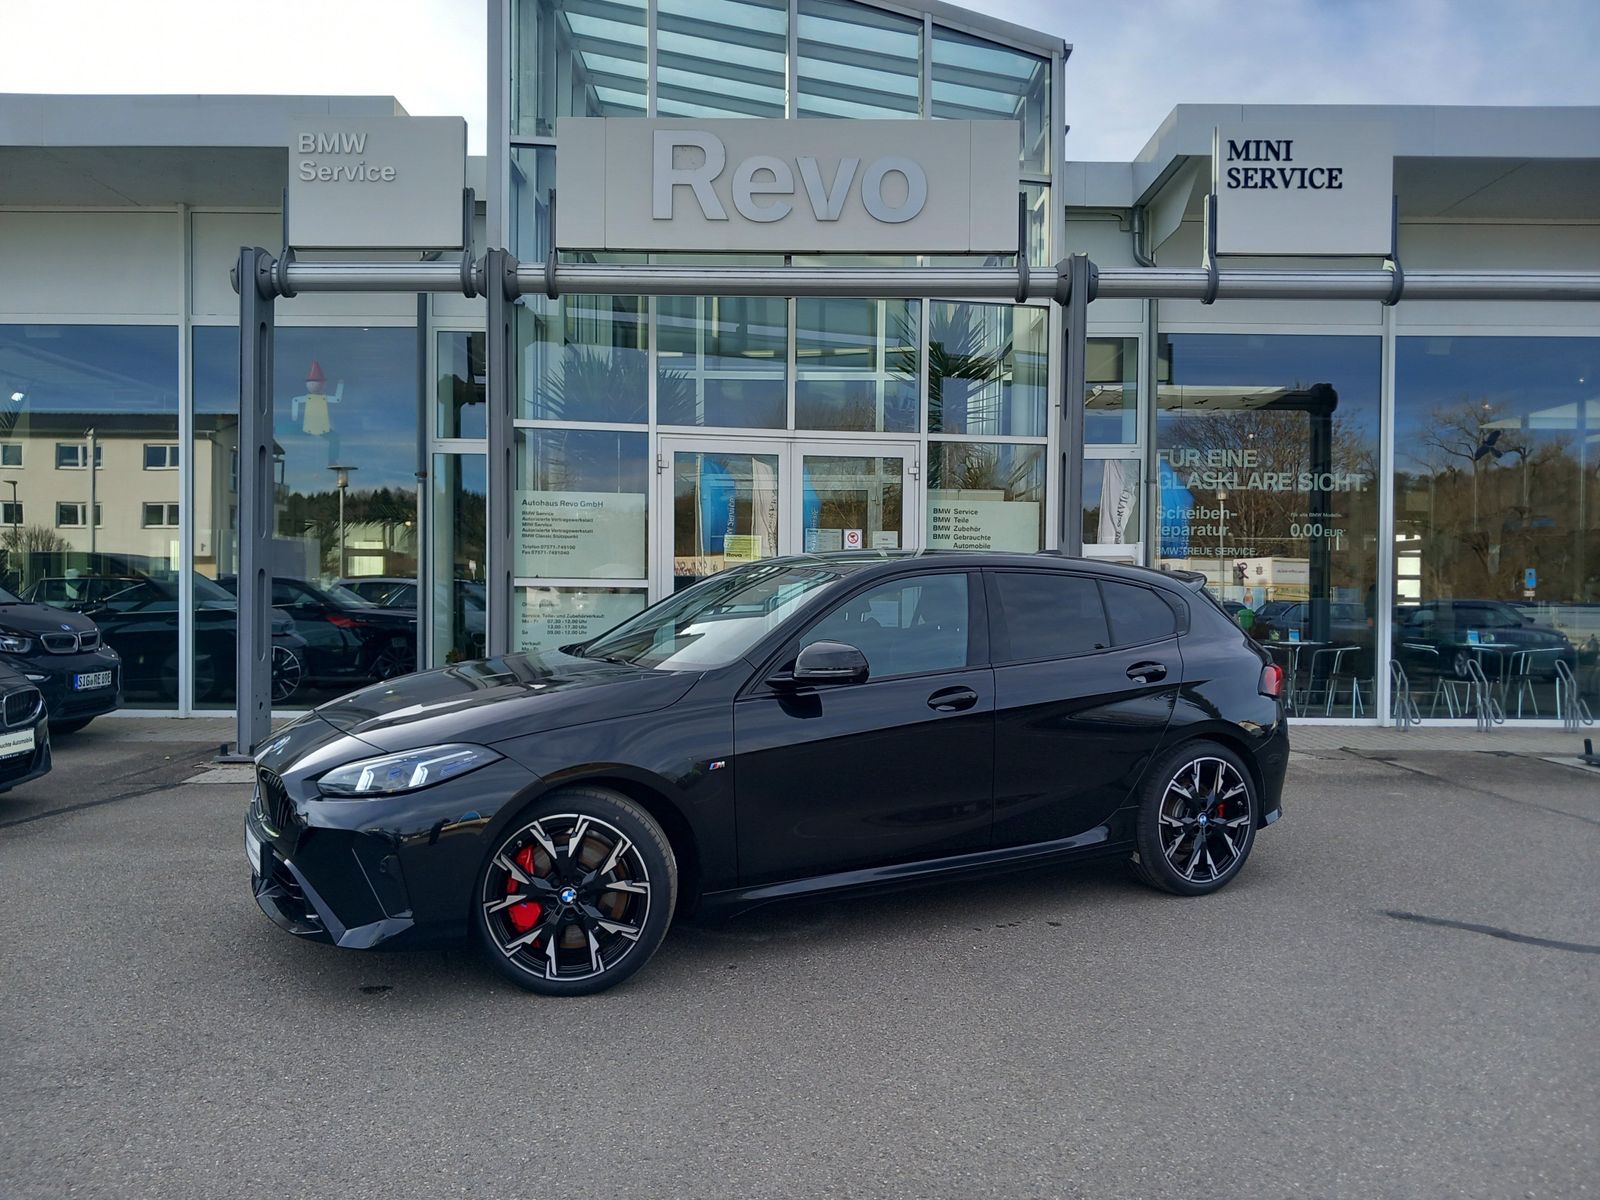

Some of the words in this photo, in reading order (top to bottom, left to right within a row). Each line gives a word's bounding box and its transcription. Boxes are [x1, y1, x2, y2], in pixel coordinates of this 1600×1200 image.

[298, 131, 368, 154] BMW
[1227, 139, 1293, 161] MINI
[299, 159, 396, 182] Service
[652, 129, 928, 224] Revo
[1227, 167, 1343, 189] SERVICE
[1157, 445, 1201, 468] FÜR
[1208, 448, 1258, 468] EINE
[1157, 471, 1292, 491] GLASKLARE
[1298, 472, 1368, 492] SICHT.
[522, 499, 558, 508] Autohaus
[560, 500, 579, 508] Revo
[580, 500, 604, 508] GmbH
[933, 507, 951, 515] BMW
[953, 508, 979, 516] Service
[1157, 505, 1238, 520] Scheiben-
[1290, 523, 1323, 539] 0,00
